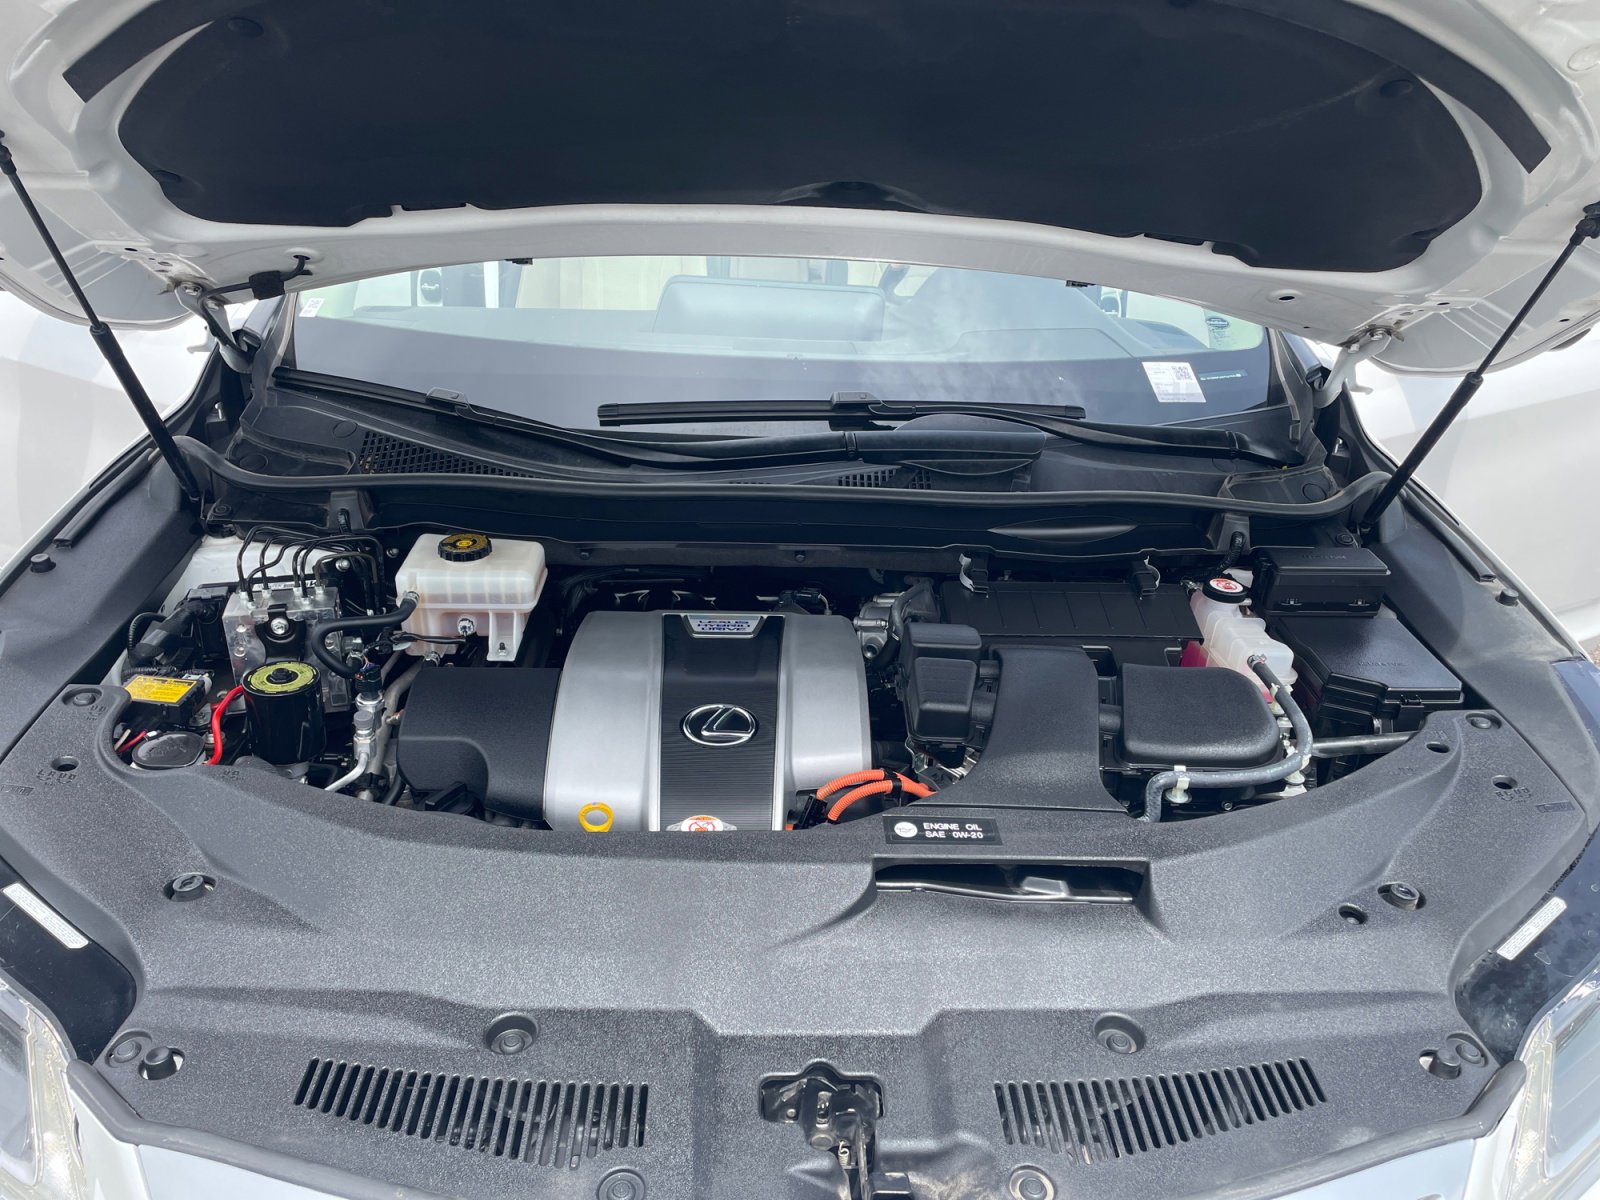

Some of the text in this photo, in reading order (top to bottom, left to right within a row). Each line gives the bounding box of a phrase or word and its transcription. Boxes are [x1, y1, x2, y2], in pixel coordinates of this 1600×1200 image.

[922, 822, 960, 831] ENGINE
[965, 823, 982, 831] OIL
[925, 830, 984, 839] SAE 0W-20
